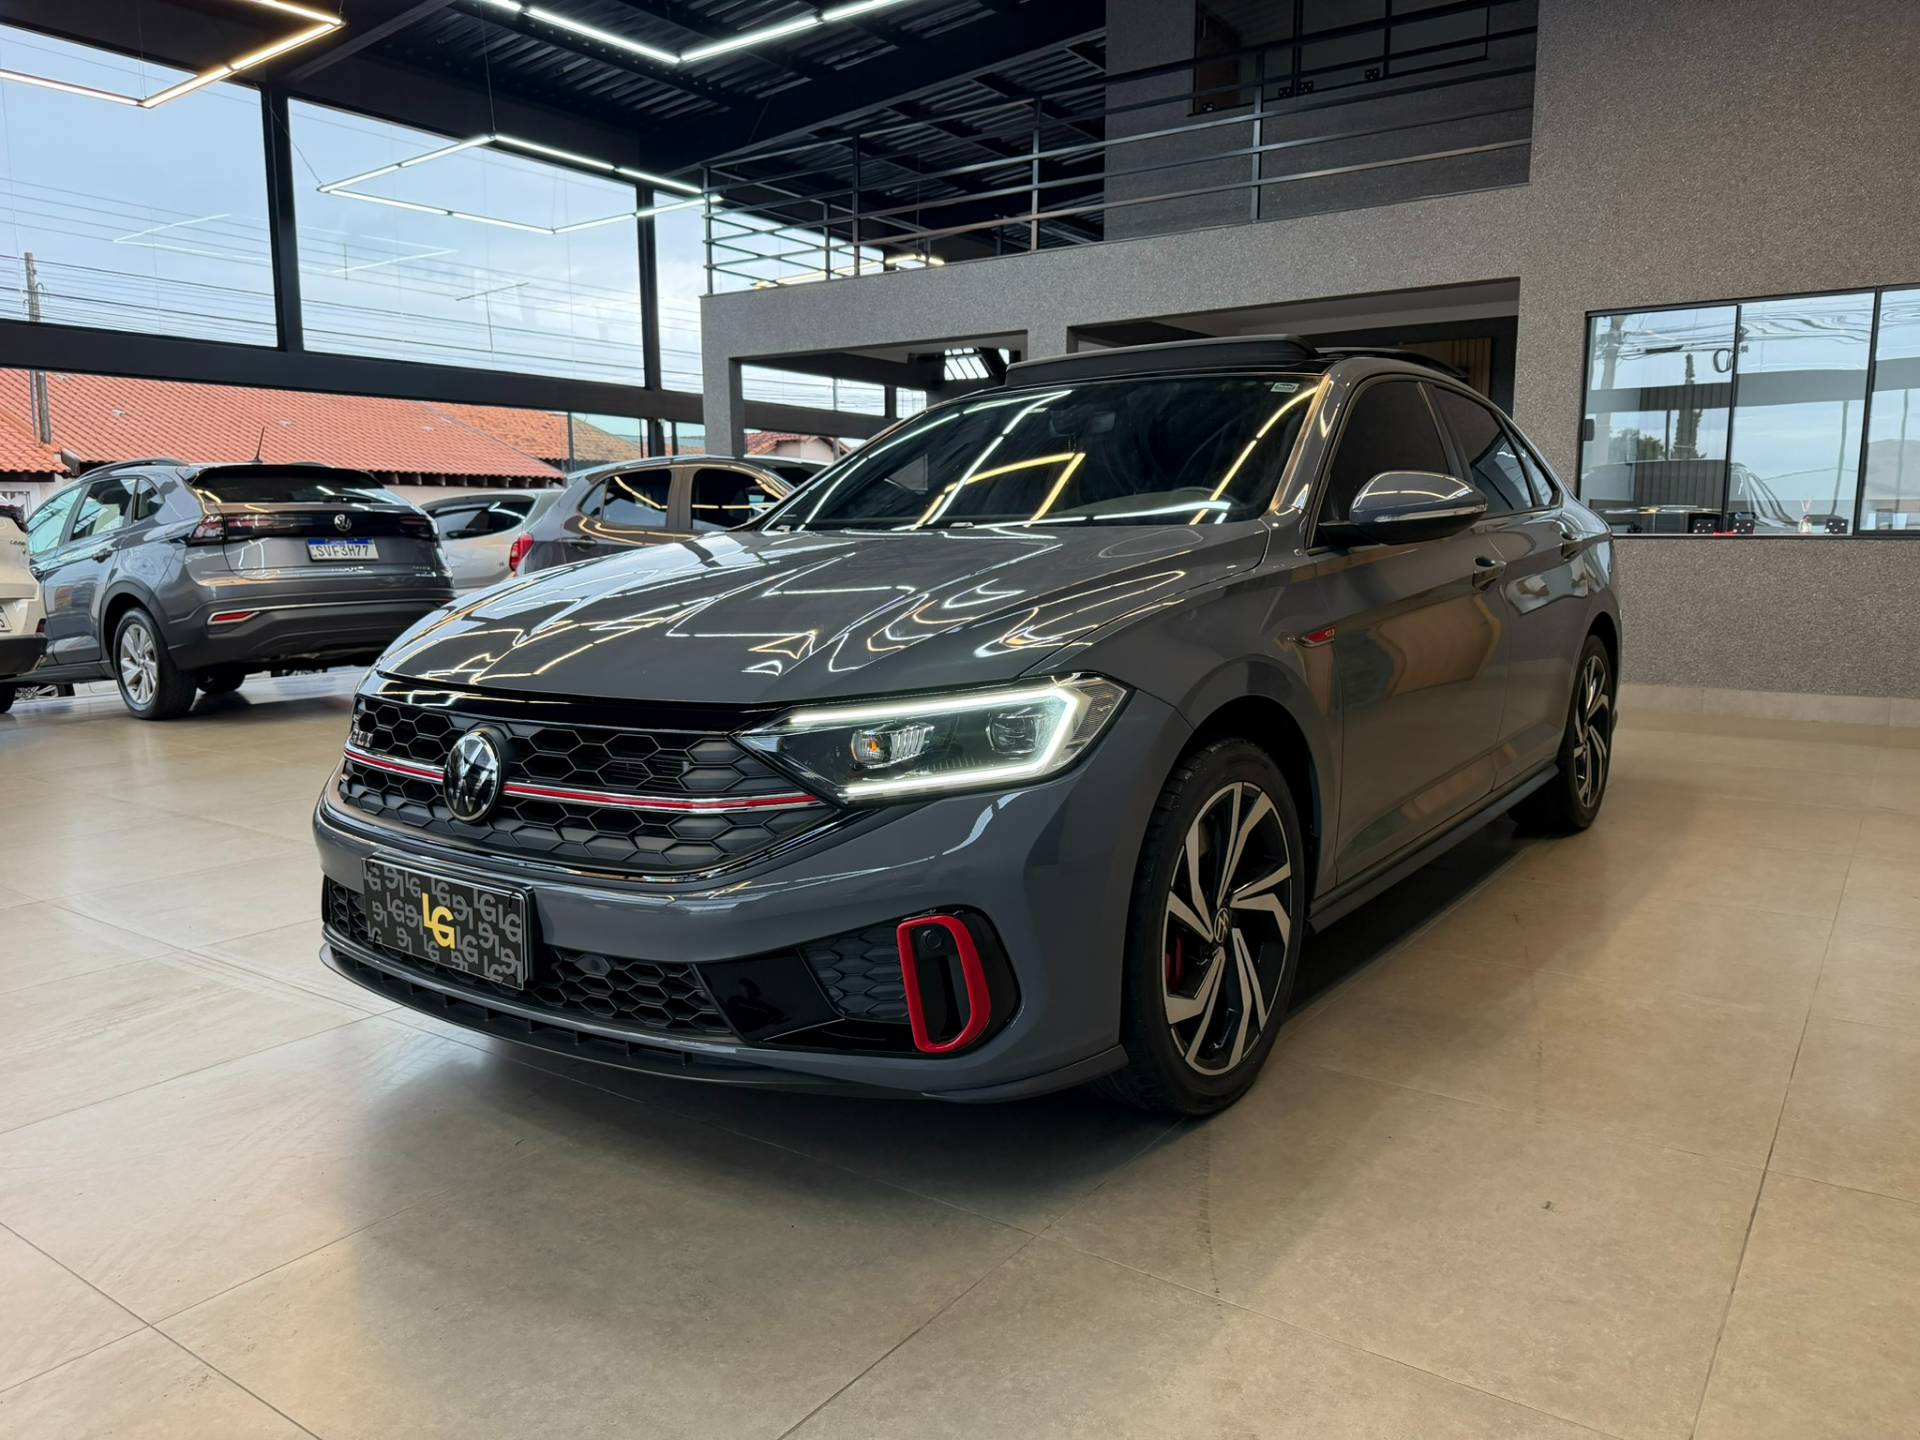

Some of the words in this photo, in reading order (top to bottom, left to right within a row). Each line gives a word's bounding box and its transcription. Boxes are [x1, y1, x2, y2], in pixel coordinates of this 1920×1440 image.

[316, 545, 369, 557] SVF3H77
[387, 892, 405, 923] LG
[431, 878, 450, 906] LG
[473, 888, 496, 923] LG
[422, 892, 456, 949] LG
[499, 904, 521, 944] LG
[456, 926, 479, 964] LG
